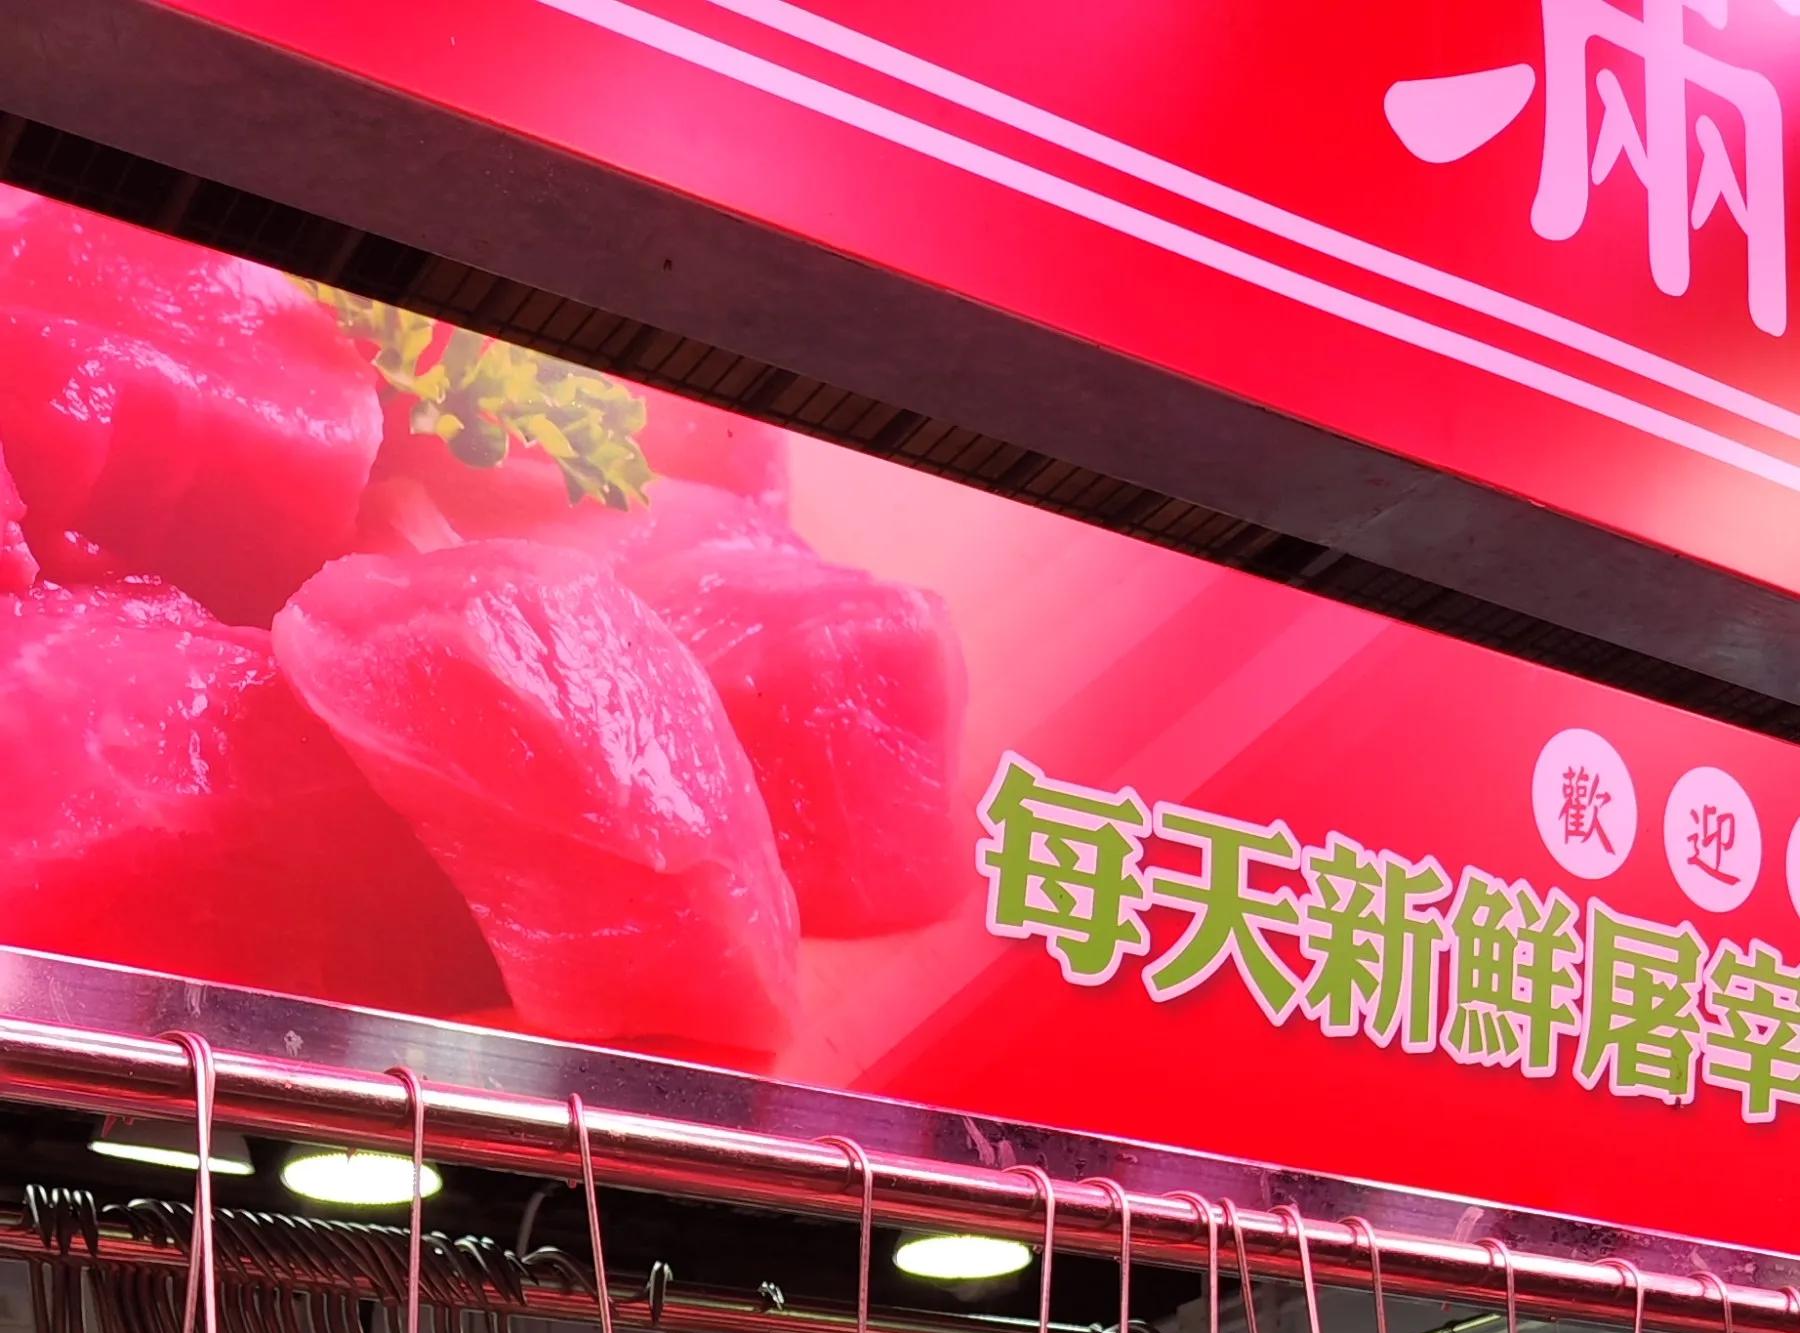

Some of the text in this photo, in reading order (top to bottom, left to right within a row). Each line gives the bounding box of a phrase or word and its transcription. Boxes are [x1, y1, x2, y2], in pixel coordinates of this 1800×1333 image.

[980, 754, 1800, 1122] 每天新鮮屠宰
